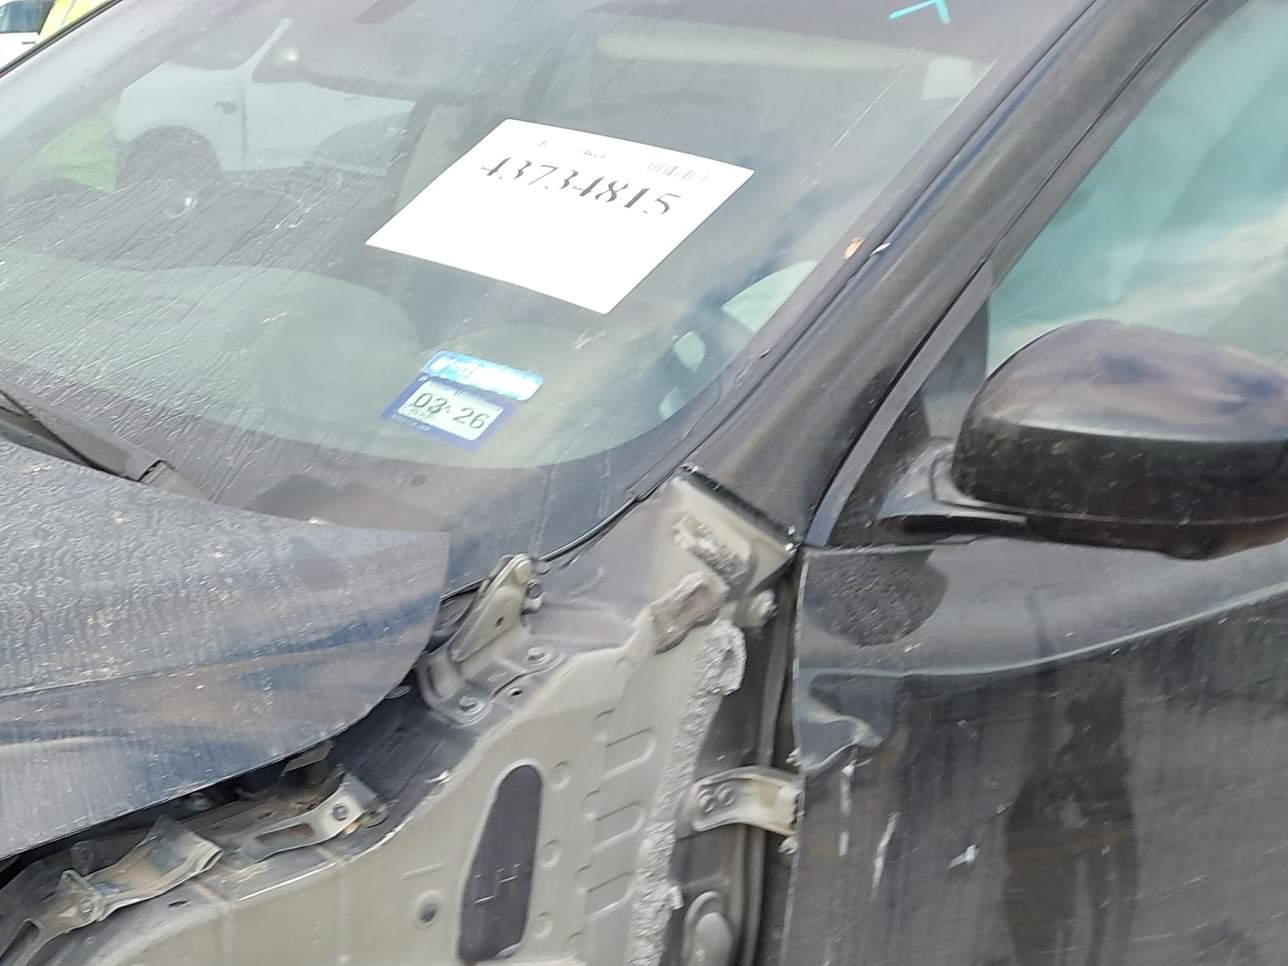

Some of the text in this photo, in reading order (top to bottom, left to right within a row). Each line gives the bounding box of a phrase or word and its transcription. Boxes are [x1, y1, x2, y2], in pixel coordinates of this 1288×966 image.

[480, 157, 682, 215] 43734815
[413, 392, 447, 415] 03
[453, 407, 491, 430] 26
